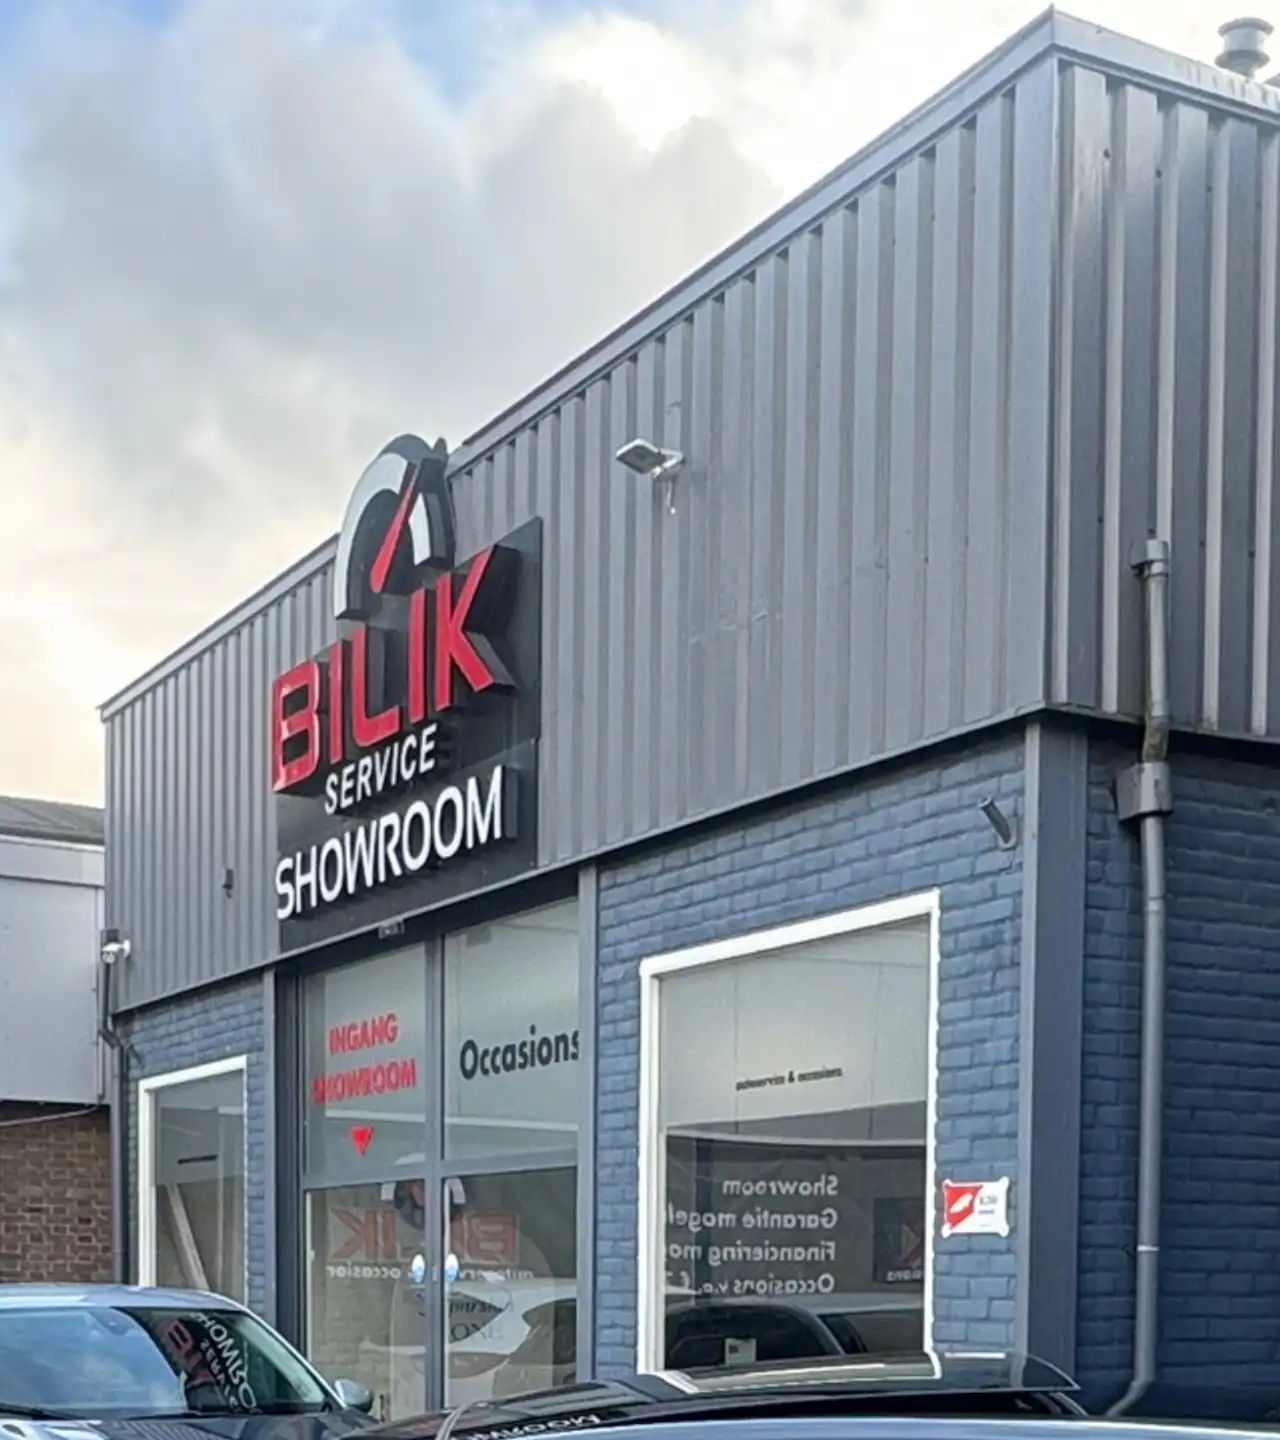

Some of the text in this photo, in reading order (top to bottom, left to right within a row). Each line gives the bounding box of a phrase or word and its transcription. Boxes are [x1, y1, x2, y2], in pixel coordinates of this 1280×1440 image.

[272, 545, 495, 792] BILIK
[324, 723, 438, 815] SERVICE
[276, 765, 504, 920] SHOWROOM
[329, 1013, 398, 1055] INGANG
[460, 1024, 579, 1080] Occasions
[313, 1057, 416, 1104] SHOWROOM
